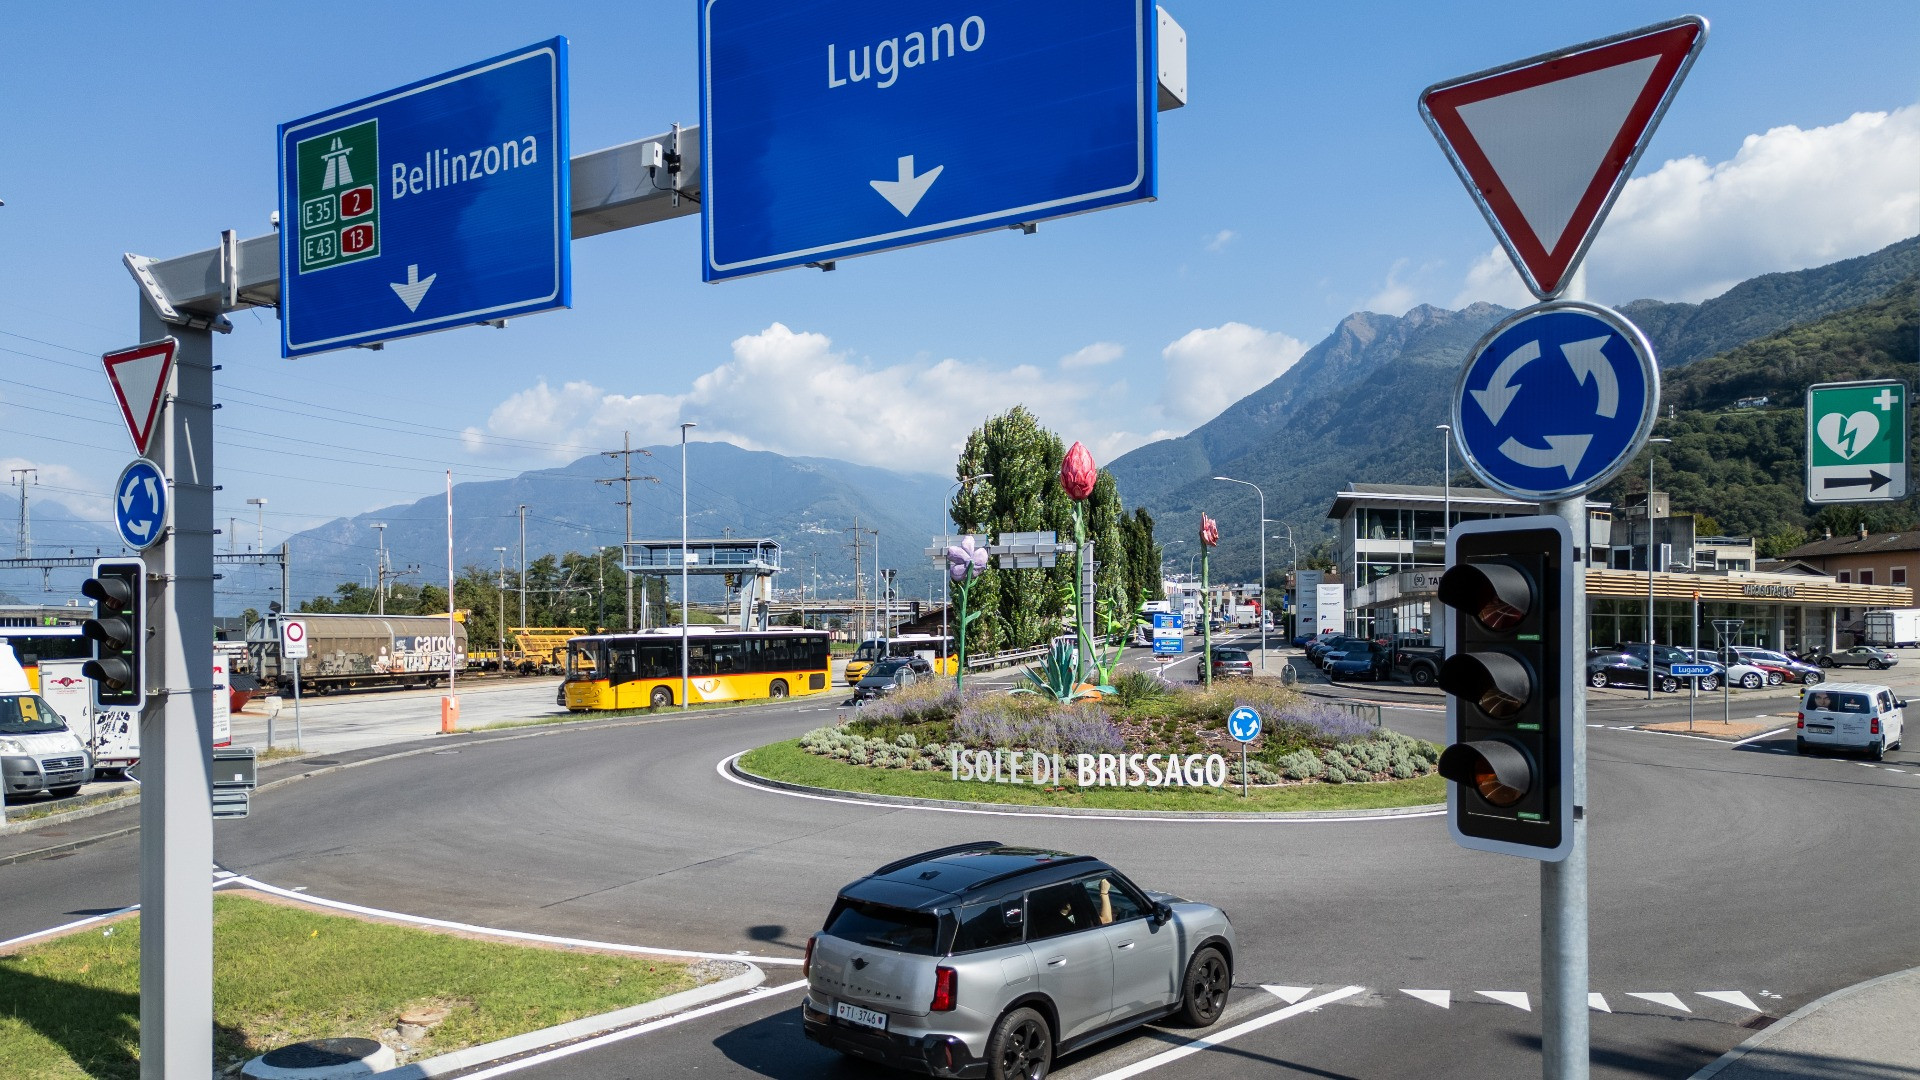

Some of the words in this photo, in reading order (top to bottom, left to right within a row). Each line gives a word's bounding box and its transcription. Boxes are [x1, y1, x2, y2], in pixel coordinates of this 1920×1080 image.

[828, 15, 986, 89] Lugano
[391, 135, 538, 200] Bellinzona
[306, 205, 313, 225] E
[315, 201, 331, 222] 35
[352, 193, 361, 213] 2
[307, 241, 314, 260] E
[316, 237, 332, 257] 43
[350, 229, 364, 250] 13
[414, 635, 456, 653] cargo
[1678, 666, 1704, 674] Lugano
[952, 749, 1024, 784] ISOLE
[1033, 752, 1059, 786] DI
[1078, 753, 1226, 788] BRISSAGO
